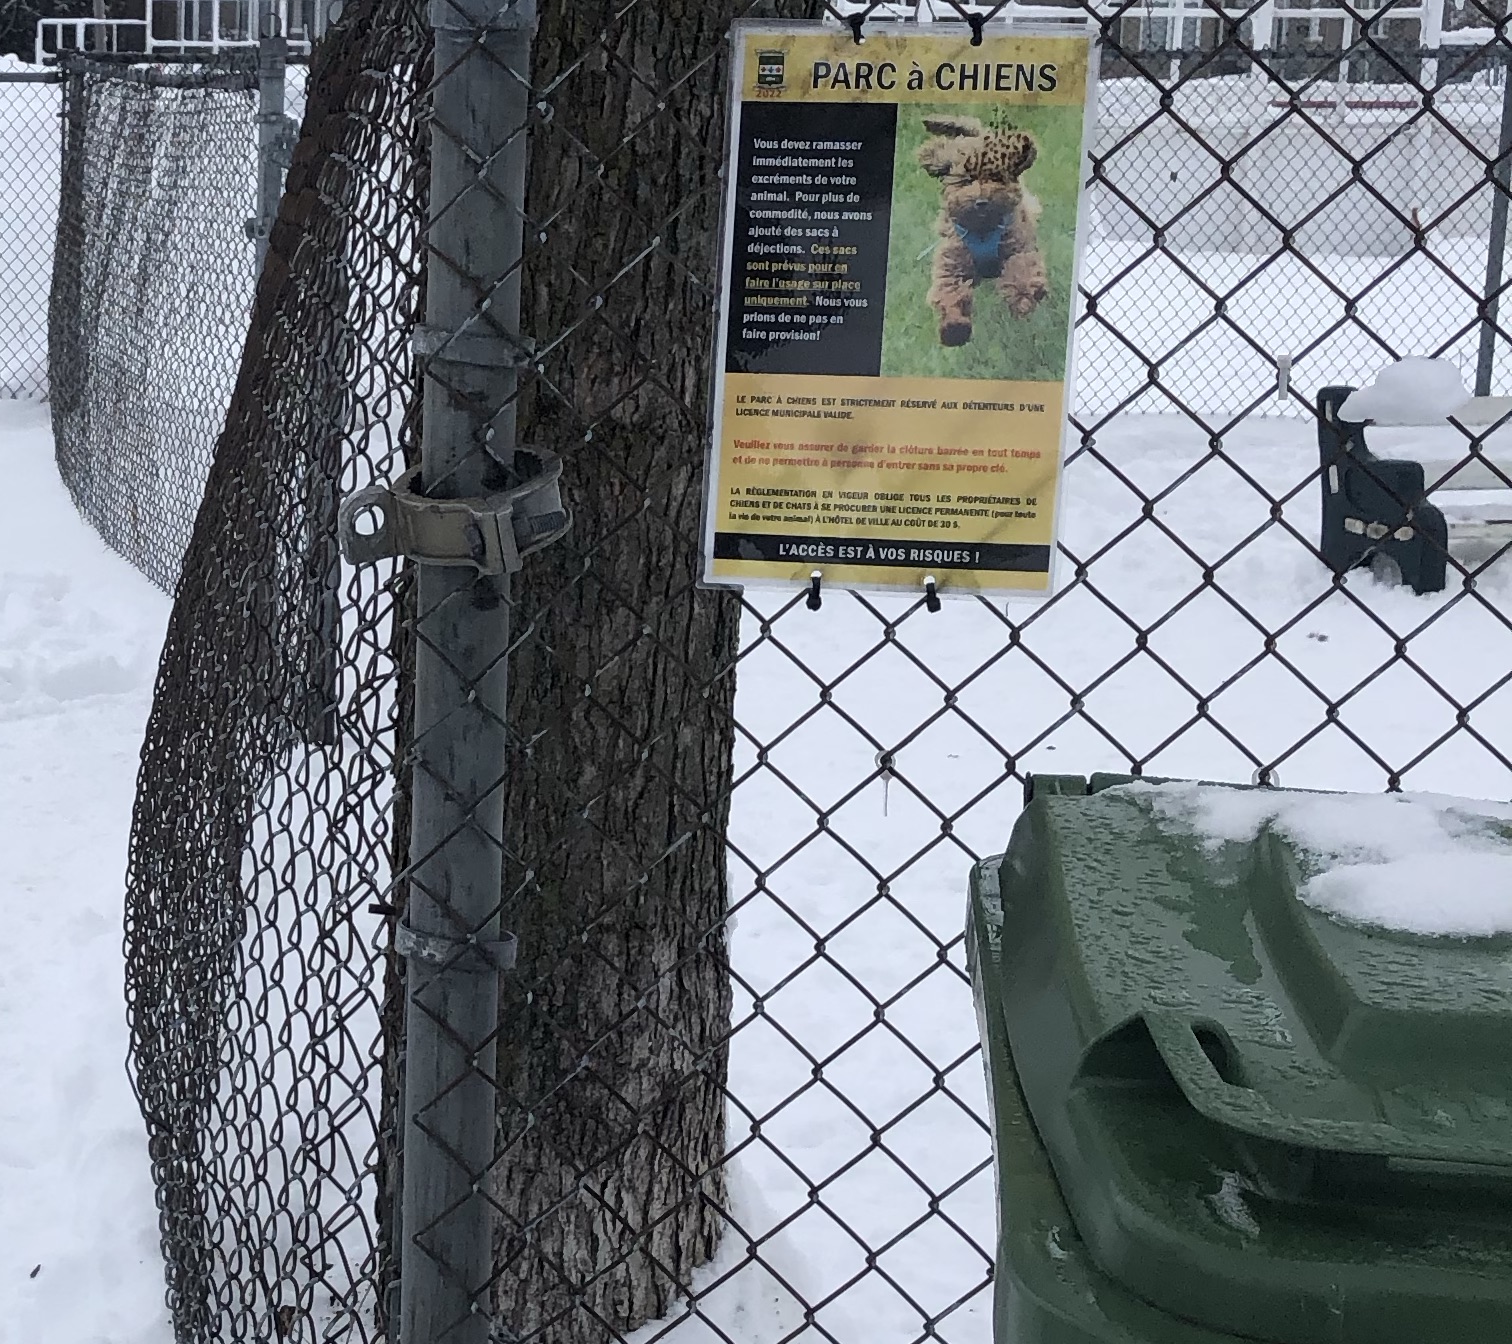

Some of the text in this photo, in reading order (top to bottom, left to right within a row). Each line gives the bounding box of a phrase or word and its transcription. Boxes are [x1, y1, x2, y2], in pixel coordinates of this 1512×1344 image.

[812, 61, 1057, 92] PARC à CHIENS
[756, 89, 782, 98] 2022
[754, 138, 863, 150] Vous devez ramasser
[753, 156, 853, 167] immédiatement les
[752, 173, 857, 185] excréments de votre
[750, 191, 860, 204] animal. Pour plus de
[749, 209, 872, 221] commodité, nous avons
[748, 226, 838, 238] ajouté des sacs à
[747, 243, 857, 255] déjections. Ces sacs
[746, 261, 848, 273] sont prévus pour en
[745, 278, 861, 291] faire l'usage sur place
[744, 294, 868, 307] uniquement. Nous vous
[743, 313, 843, 325] prions de ne pas en
[742, 329, 821, 341] faire provision!
[737, 395, 1045, 412] LE PARC À CHIENS EST STRICTEMENT RÉSERVÉ AUX DÉTENTEURS D'UNE
[772, 410, 821, 418] MUNICIPALE
[823, 411, 855, 419] VALIDE.
[734, 440, 1041, 459] Veuillez vous assurer de garder la clôture barrée en tout temps
[732, 456, 743, 464] et
[745, 456, 757, 464] de
[772, 457, 820, 468] permettre
[822, 458, 828, 467] à
[830, 459, 874, 468] personne
[877, 460, 916, 470] d'entrer
[918, 463, 940, 471] sans
[956, 464, 988, 473] propre
[991, 464, 1008, 473] clé.
[839, 491, 868, 499] VIGEUR
[874, 492, 904, 501] OBLIGE
[910, 494, 931, 502] TOUS
[936, 495, 951, 503] LES
[957, 494, 1021, 505] PROPRIÉTAIRES
[1026, 497, 1037, 505] DE
[730, 500, 760, 508] CHIENS
[785, 502, 811, 510] CHATS
[813, 501, 819, 511] À
[833, 504, 877, 512] PROCURER
[880, 505, 897, 513] UNE
[899, 507, 933, 515] LICENCE
[935, 508, 989, 517] PERMANENTE
[815, 515, 821, 523] À
[823, 516, 853, 525] L'HÔTEL
[856, 517, 866, 525] DE
[868, 517, 889, 526] VILLE
[904, 517, 925, 527] COÛT
[779, 542, 979, 564] L'ACCÈS EST À VOS RISQUES !
